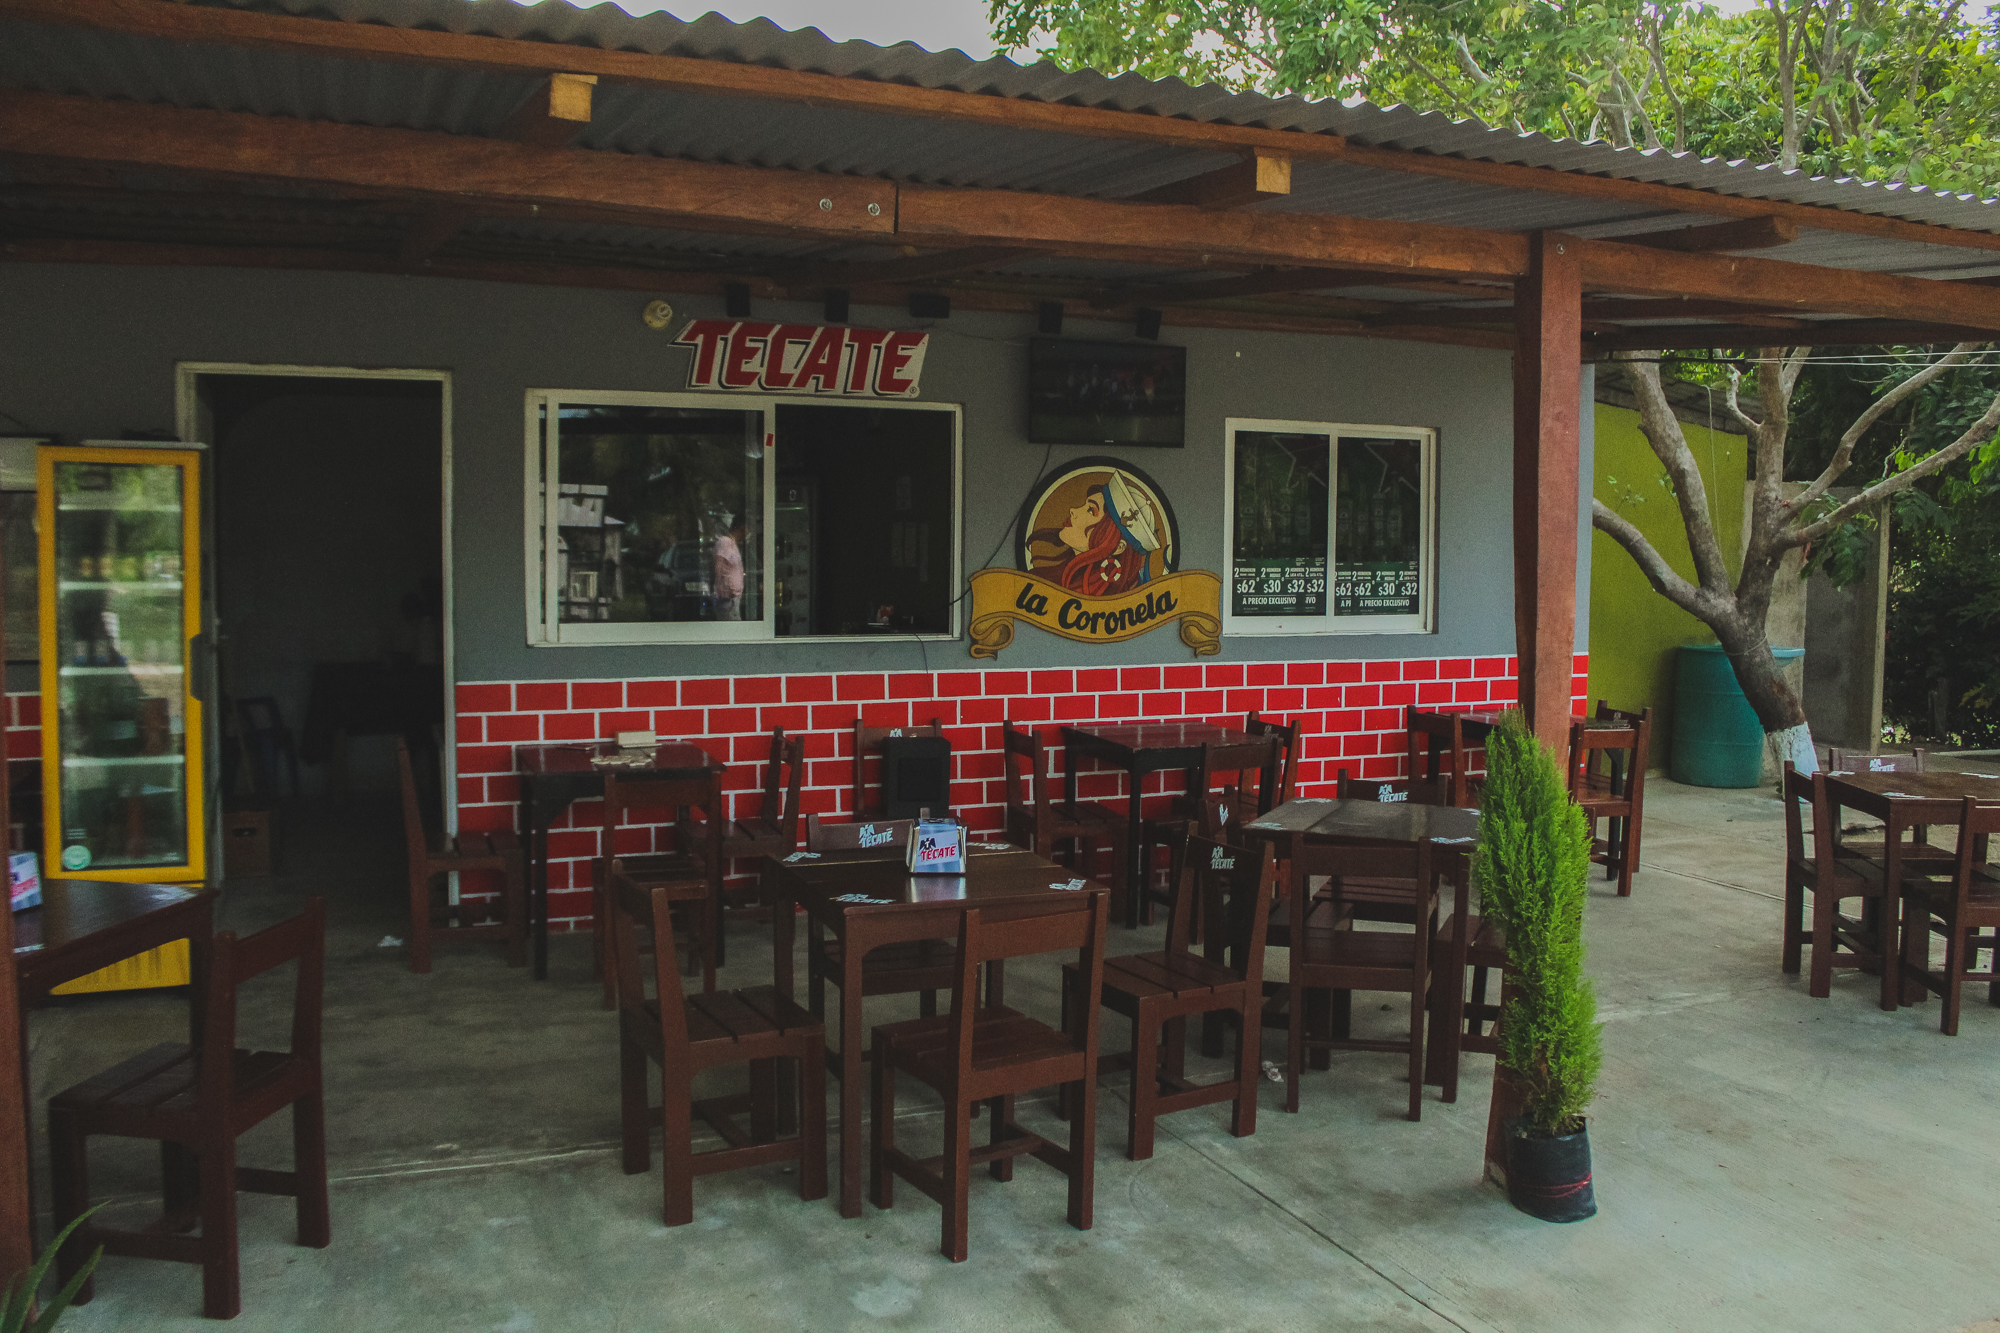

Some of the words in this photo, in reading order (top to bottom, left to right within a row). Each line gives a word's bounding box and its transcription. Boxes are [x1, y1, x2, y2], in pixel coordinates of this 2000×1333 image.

[680, 319, 930, 397] TECATE
[1234, 567, 1240, 578] 2
[1261, 567, 1266, 578] 2
[1285, 567, 1290, 578] 2
[1352, 571, 1357, 581] 2
[1376, 571, 1381, 581] 2
[1399, 571, 1404, 581] 2
[1236, 579, 1256, 594] $62
[1263, 579, 1281, 594] $30
[1287, 579, 1305, 593] $32
[1306, 579, 1325, 593] $32
[1335, 583, 1352, 596] $62
[1354, 583, 1372, 596] $62
[1378, 583, 1395, 596] $30
[1401, 582, 1418, 596] $32
[1242, 597, 1247, 605] A
[1248, 597, 1268, 605] PRECIO
[1268, 596, 1297, 605] EXCLUSIVO
[1383, 599, 1410, 607] EXCLUSIVO
[1058, 590, 1178, 635] Coronela
[1377, 791, 1409, 803] TECATE
[858, 830, 894, 849] TECATE
[918, 845, 957, 862] TECATE
[1210, 858, 1236, 870] TECATE
